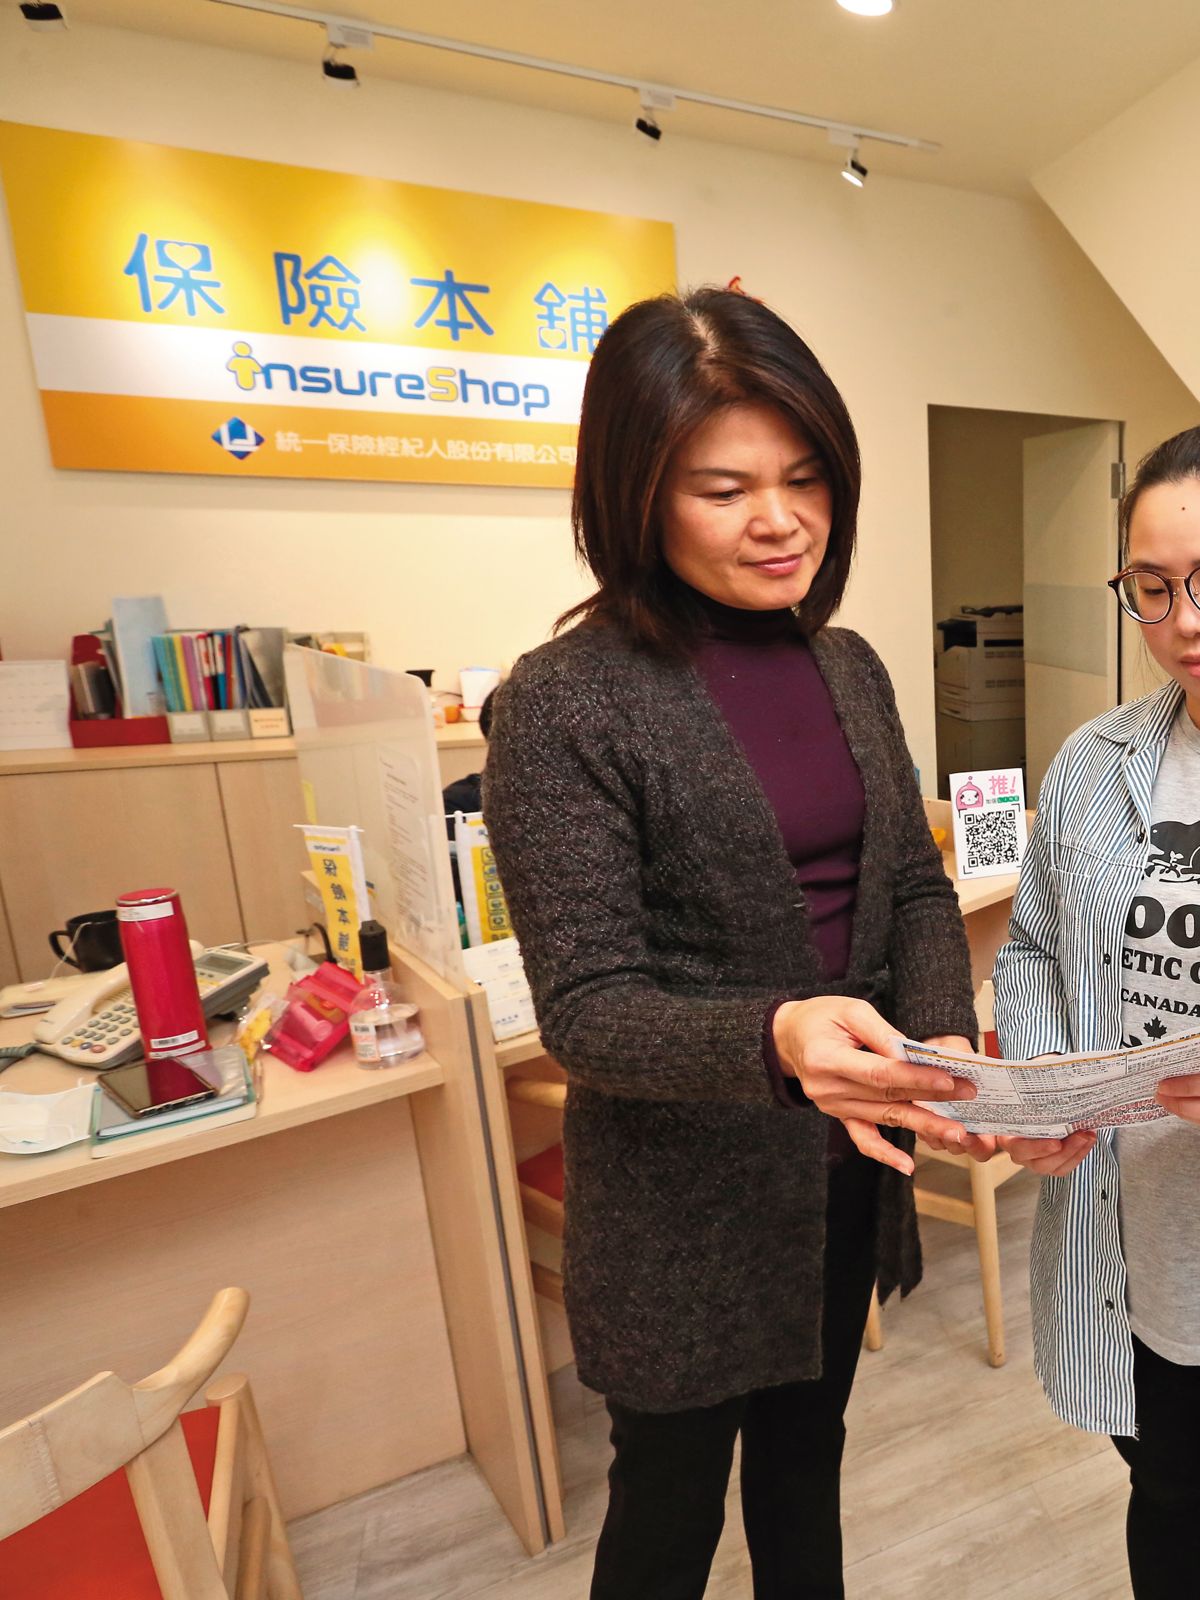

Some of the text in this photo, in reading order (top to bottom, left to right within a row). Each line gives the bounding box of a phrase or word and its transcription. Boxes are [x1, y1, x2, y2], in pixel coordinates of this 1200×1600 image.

[275, 430, 578, 466] 統一保險經紀人股份有限公司
